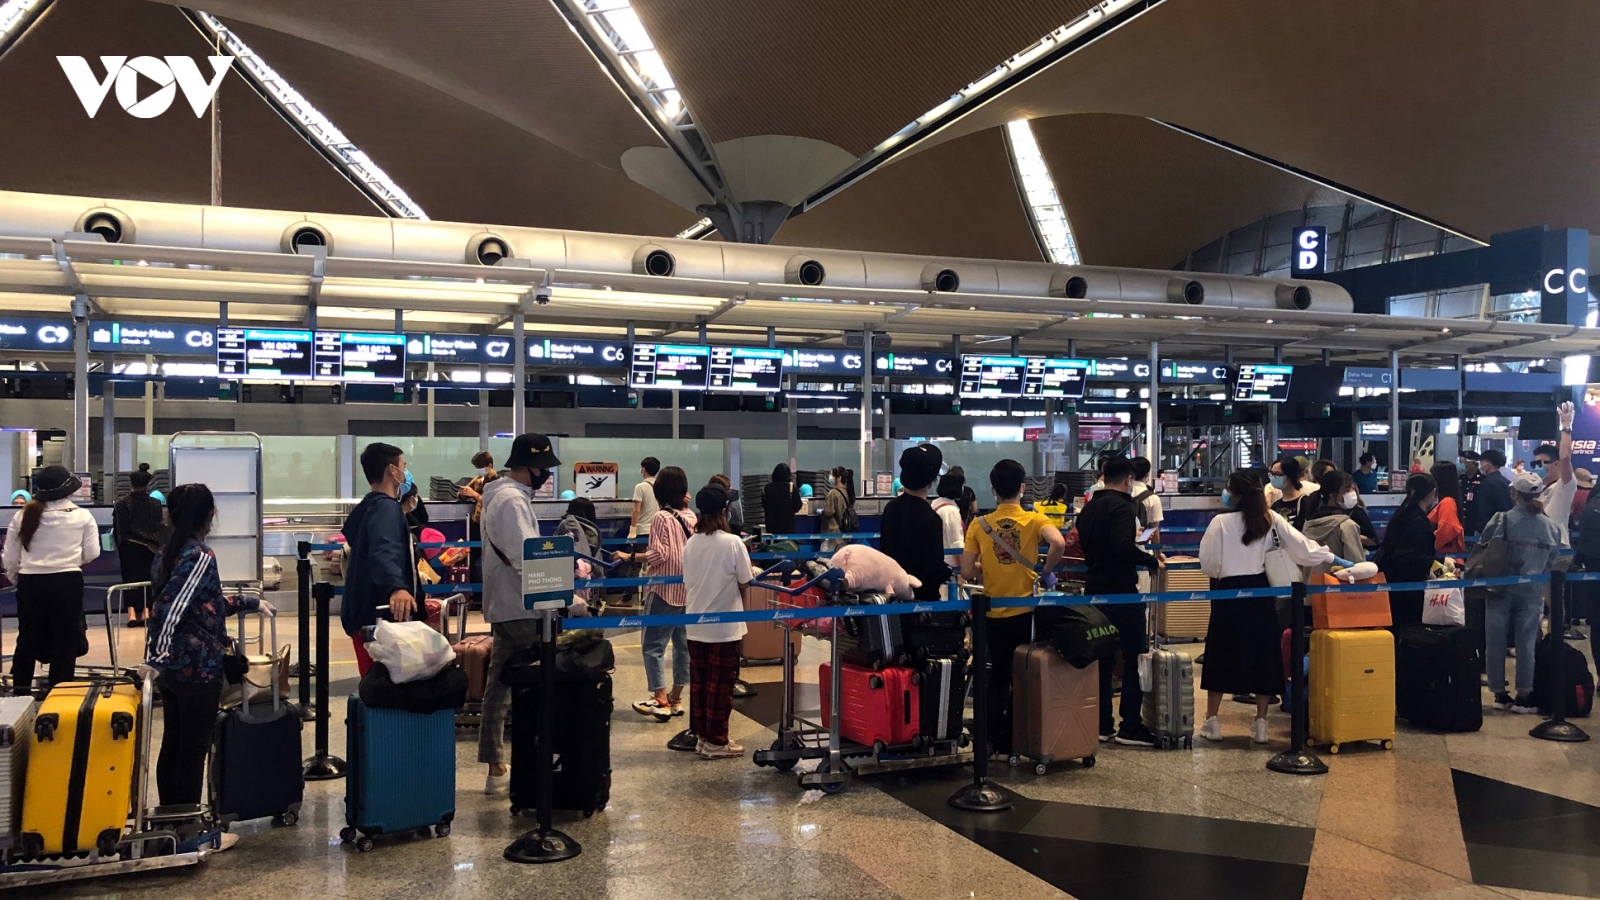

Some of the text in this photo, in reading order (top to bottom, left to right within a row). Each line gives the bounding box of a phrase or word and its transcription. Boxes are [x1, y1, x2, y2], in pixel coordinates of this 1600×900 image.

[38, 326, 69, 343] C9
[185, 331, 213, 347] C8
[486, 342, 510, 357] C7
[602, 346, 624, 361] C6
[843, 355, 861, 369] C5
[936, 359, 952, 372] C4
[1134, 364, 1149, 377] C3
[1212, 367, 1227, 379] C2
[1381, 373, 1392, 384] C1
[586, 465, 615, 473] WARNING
